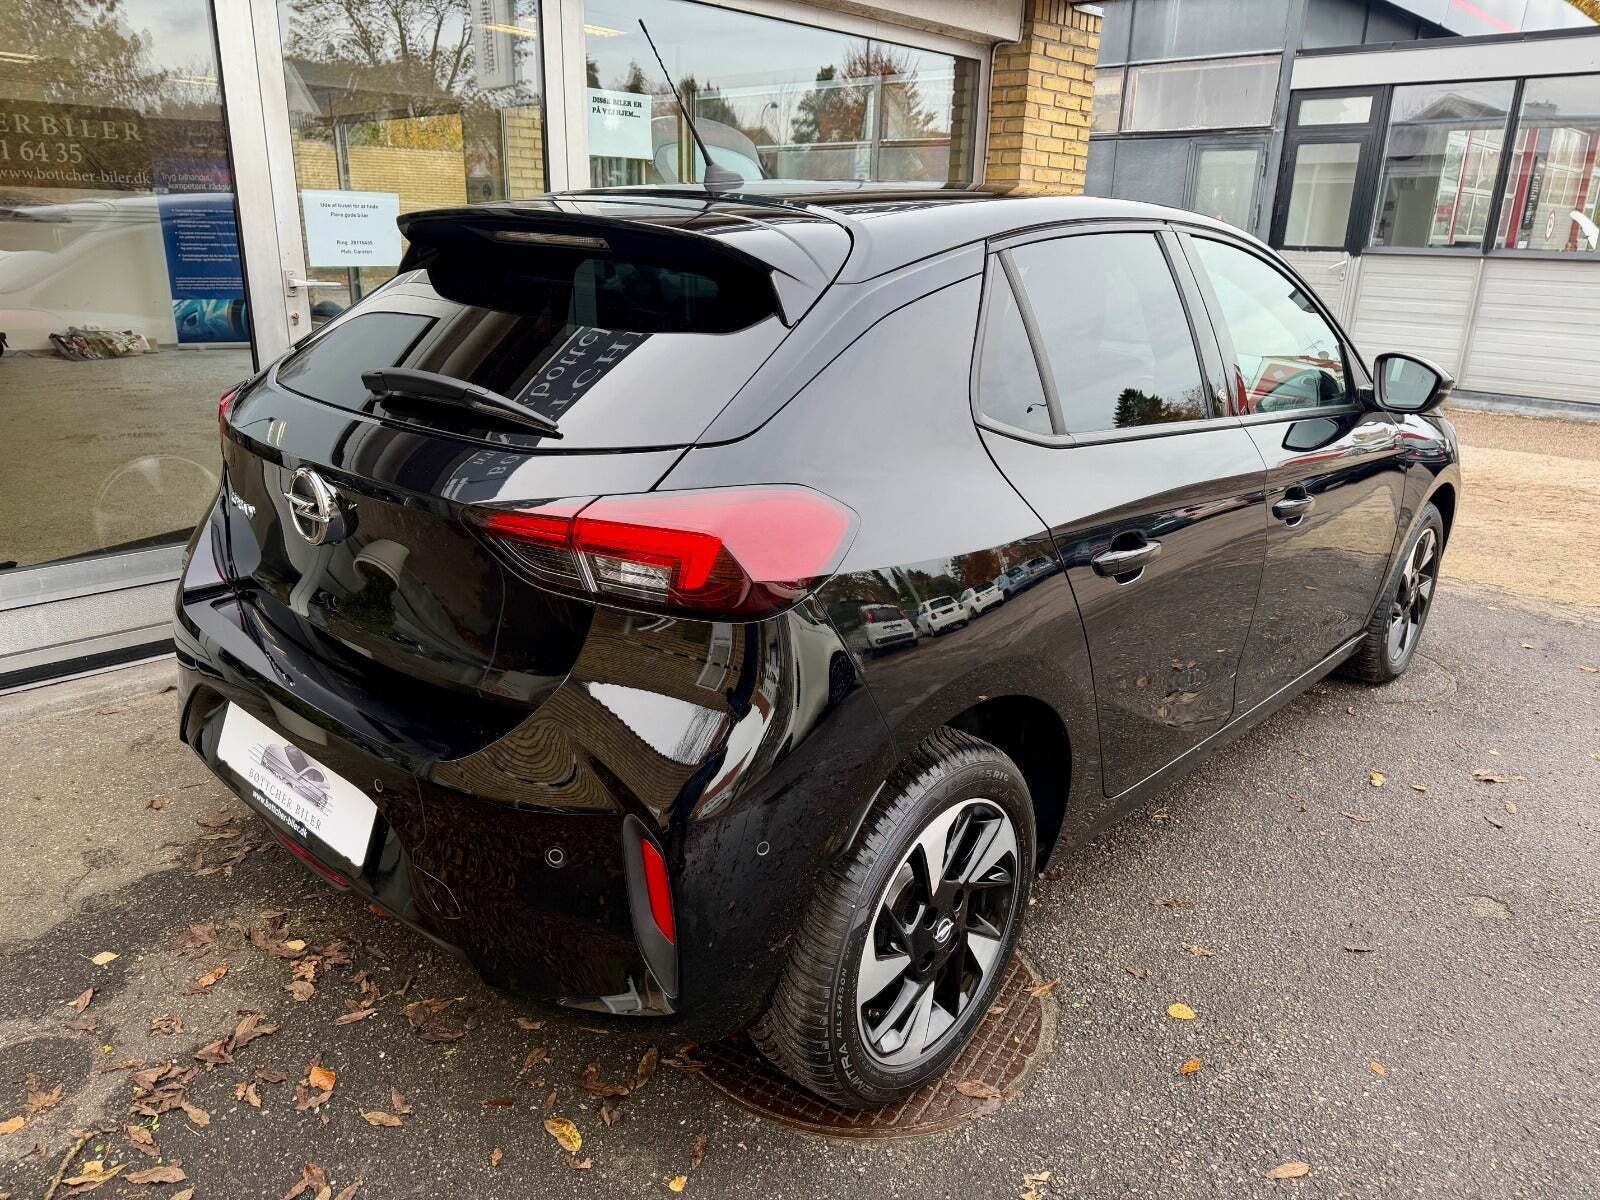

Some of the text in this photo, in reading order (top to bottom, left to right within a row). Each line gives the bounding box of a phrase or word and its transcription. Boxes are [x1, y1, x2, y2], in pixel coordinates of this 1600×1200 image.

[592, 105, 601, 114] PÅ
[40, 114, 143, 141] BILER
[20, 140, 49, 162] 64
[56, 142, 82, 163] 35
[294, 803, 322, 832] BILER
